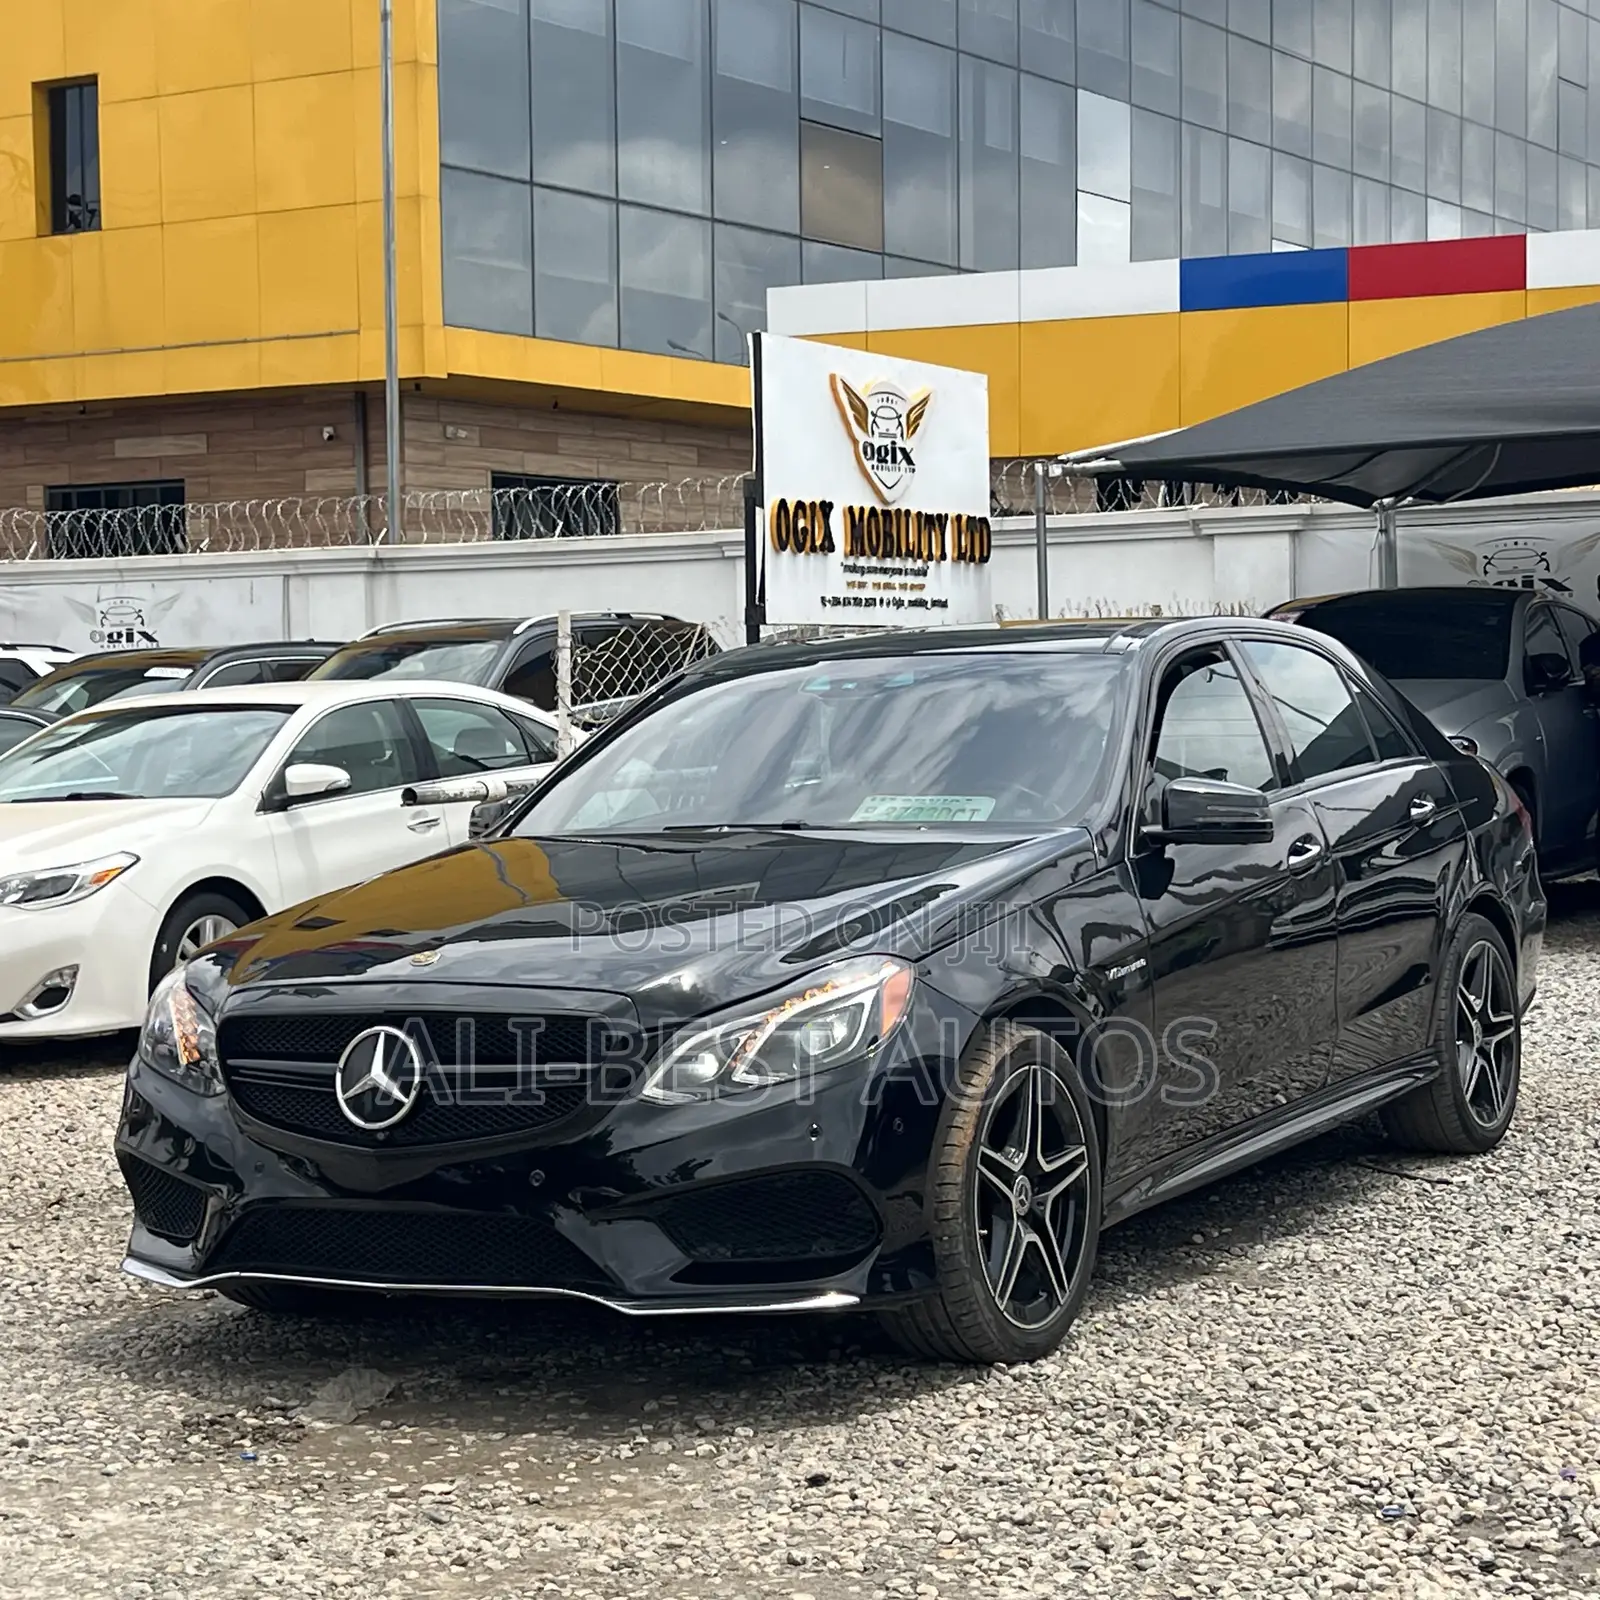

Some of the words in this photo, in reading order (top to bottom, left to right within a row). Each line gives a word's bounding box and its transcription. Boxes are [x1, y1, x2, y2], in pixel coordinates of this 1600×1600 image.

[770, 498, 836, 554] OGIX
[843, 505, 949, 563] MOBILITY
[950, 513, 992, 565] LTD
